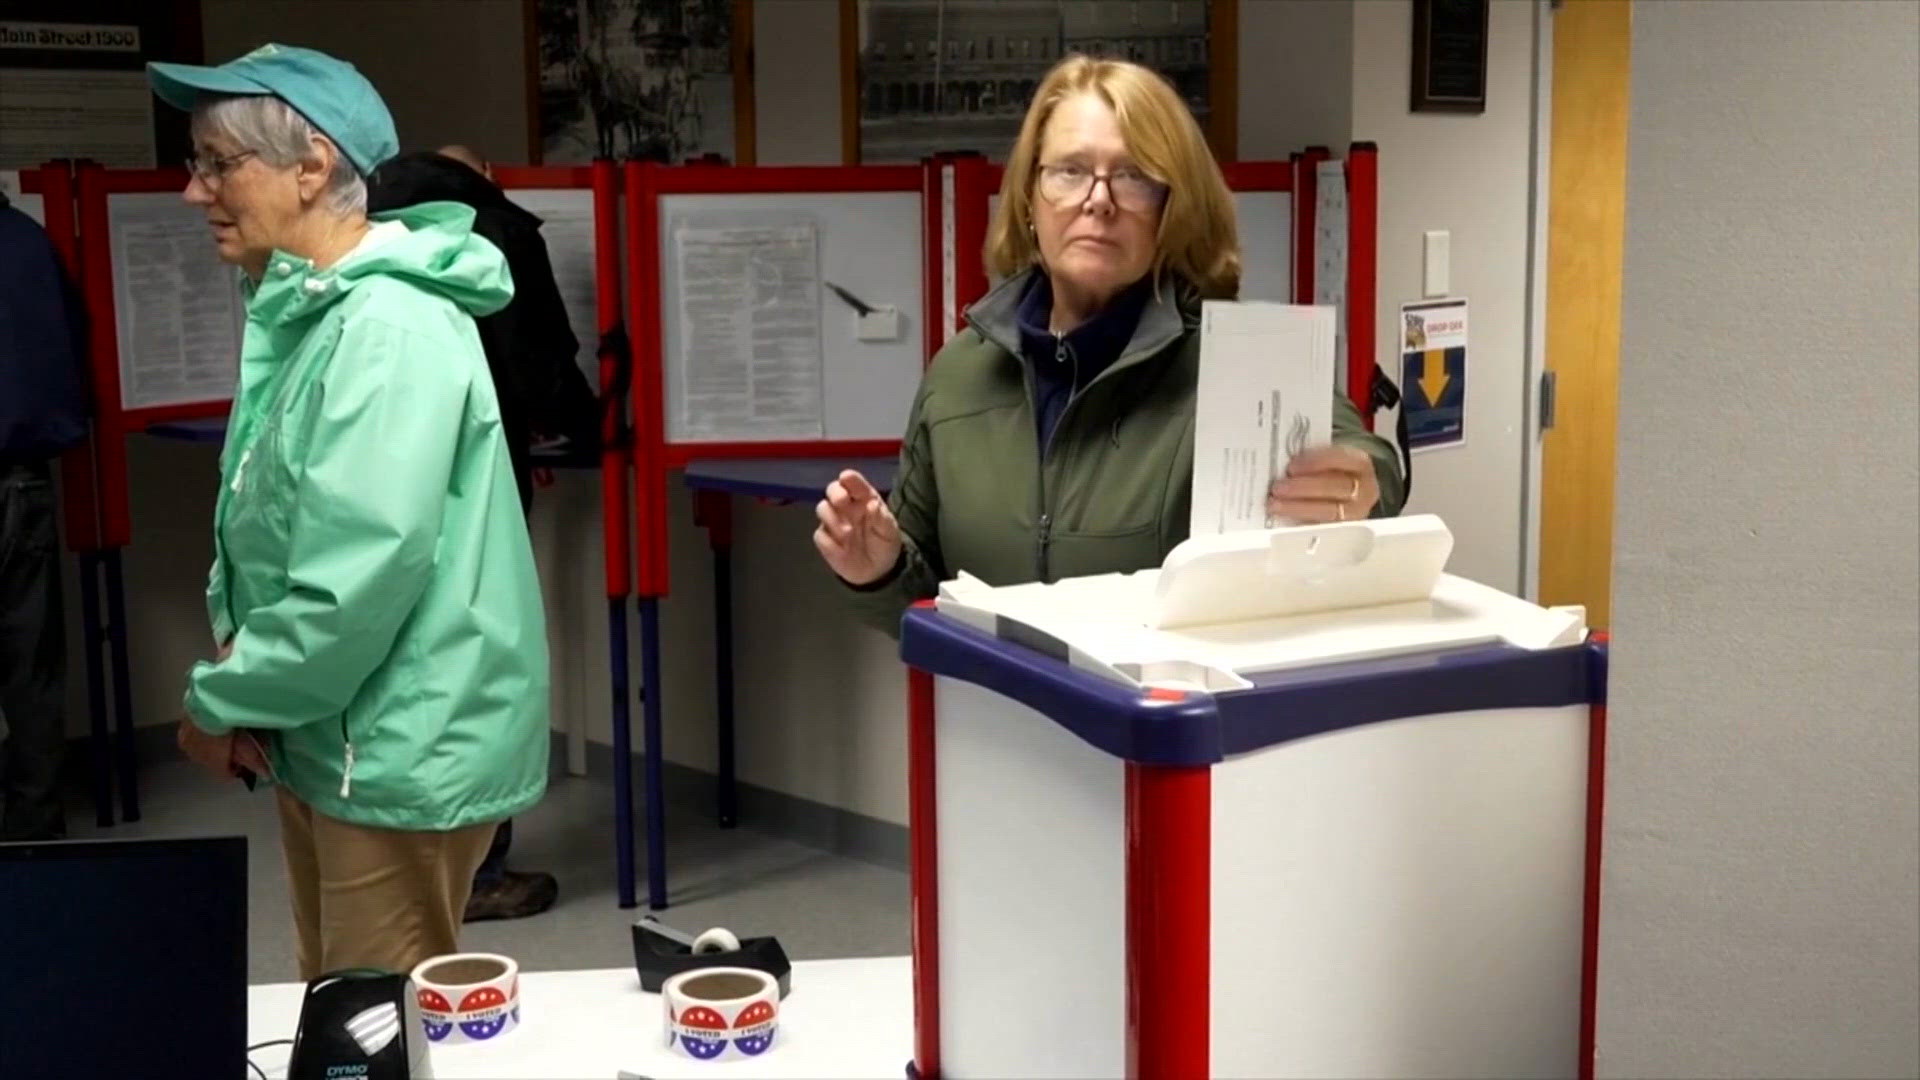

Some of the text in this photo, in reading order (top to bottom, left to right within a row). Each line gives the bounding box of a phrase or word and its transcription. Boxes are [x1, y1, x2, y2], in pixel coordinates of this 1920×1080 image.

[39, 29, 95, 46] Street
[96, 31, 135, 46] 1900
[1427, 321, 1448, 333] DROP
[472, 1007, 502, 1018] VOTED
[691, 1029, 721, 1037] VOTED
[326, 1063, 369, 1077] DYMO
